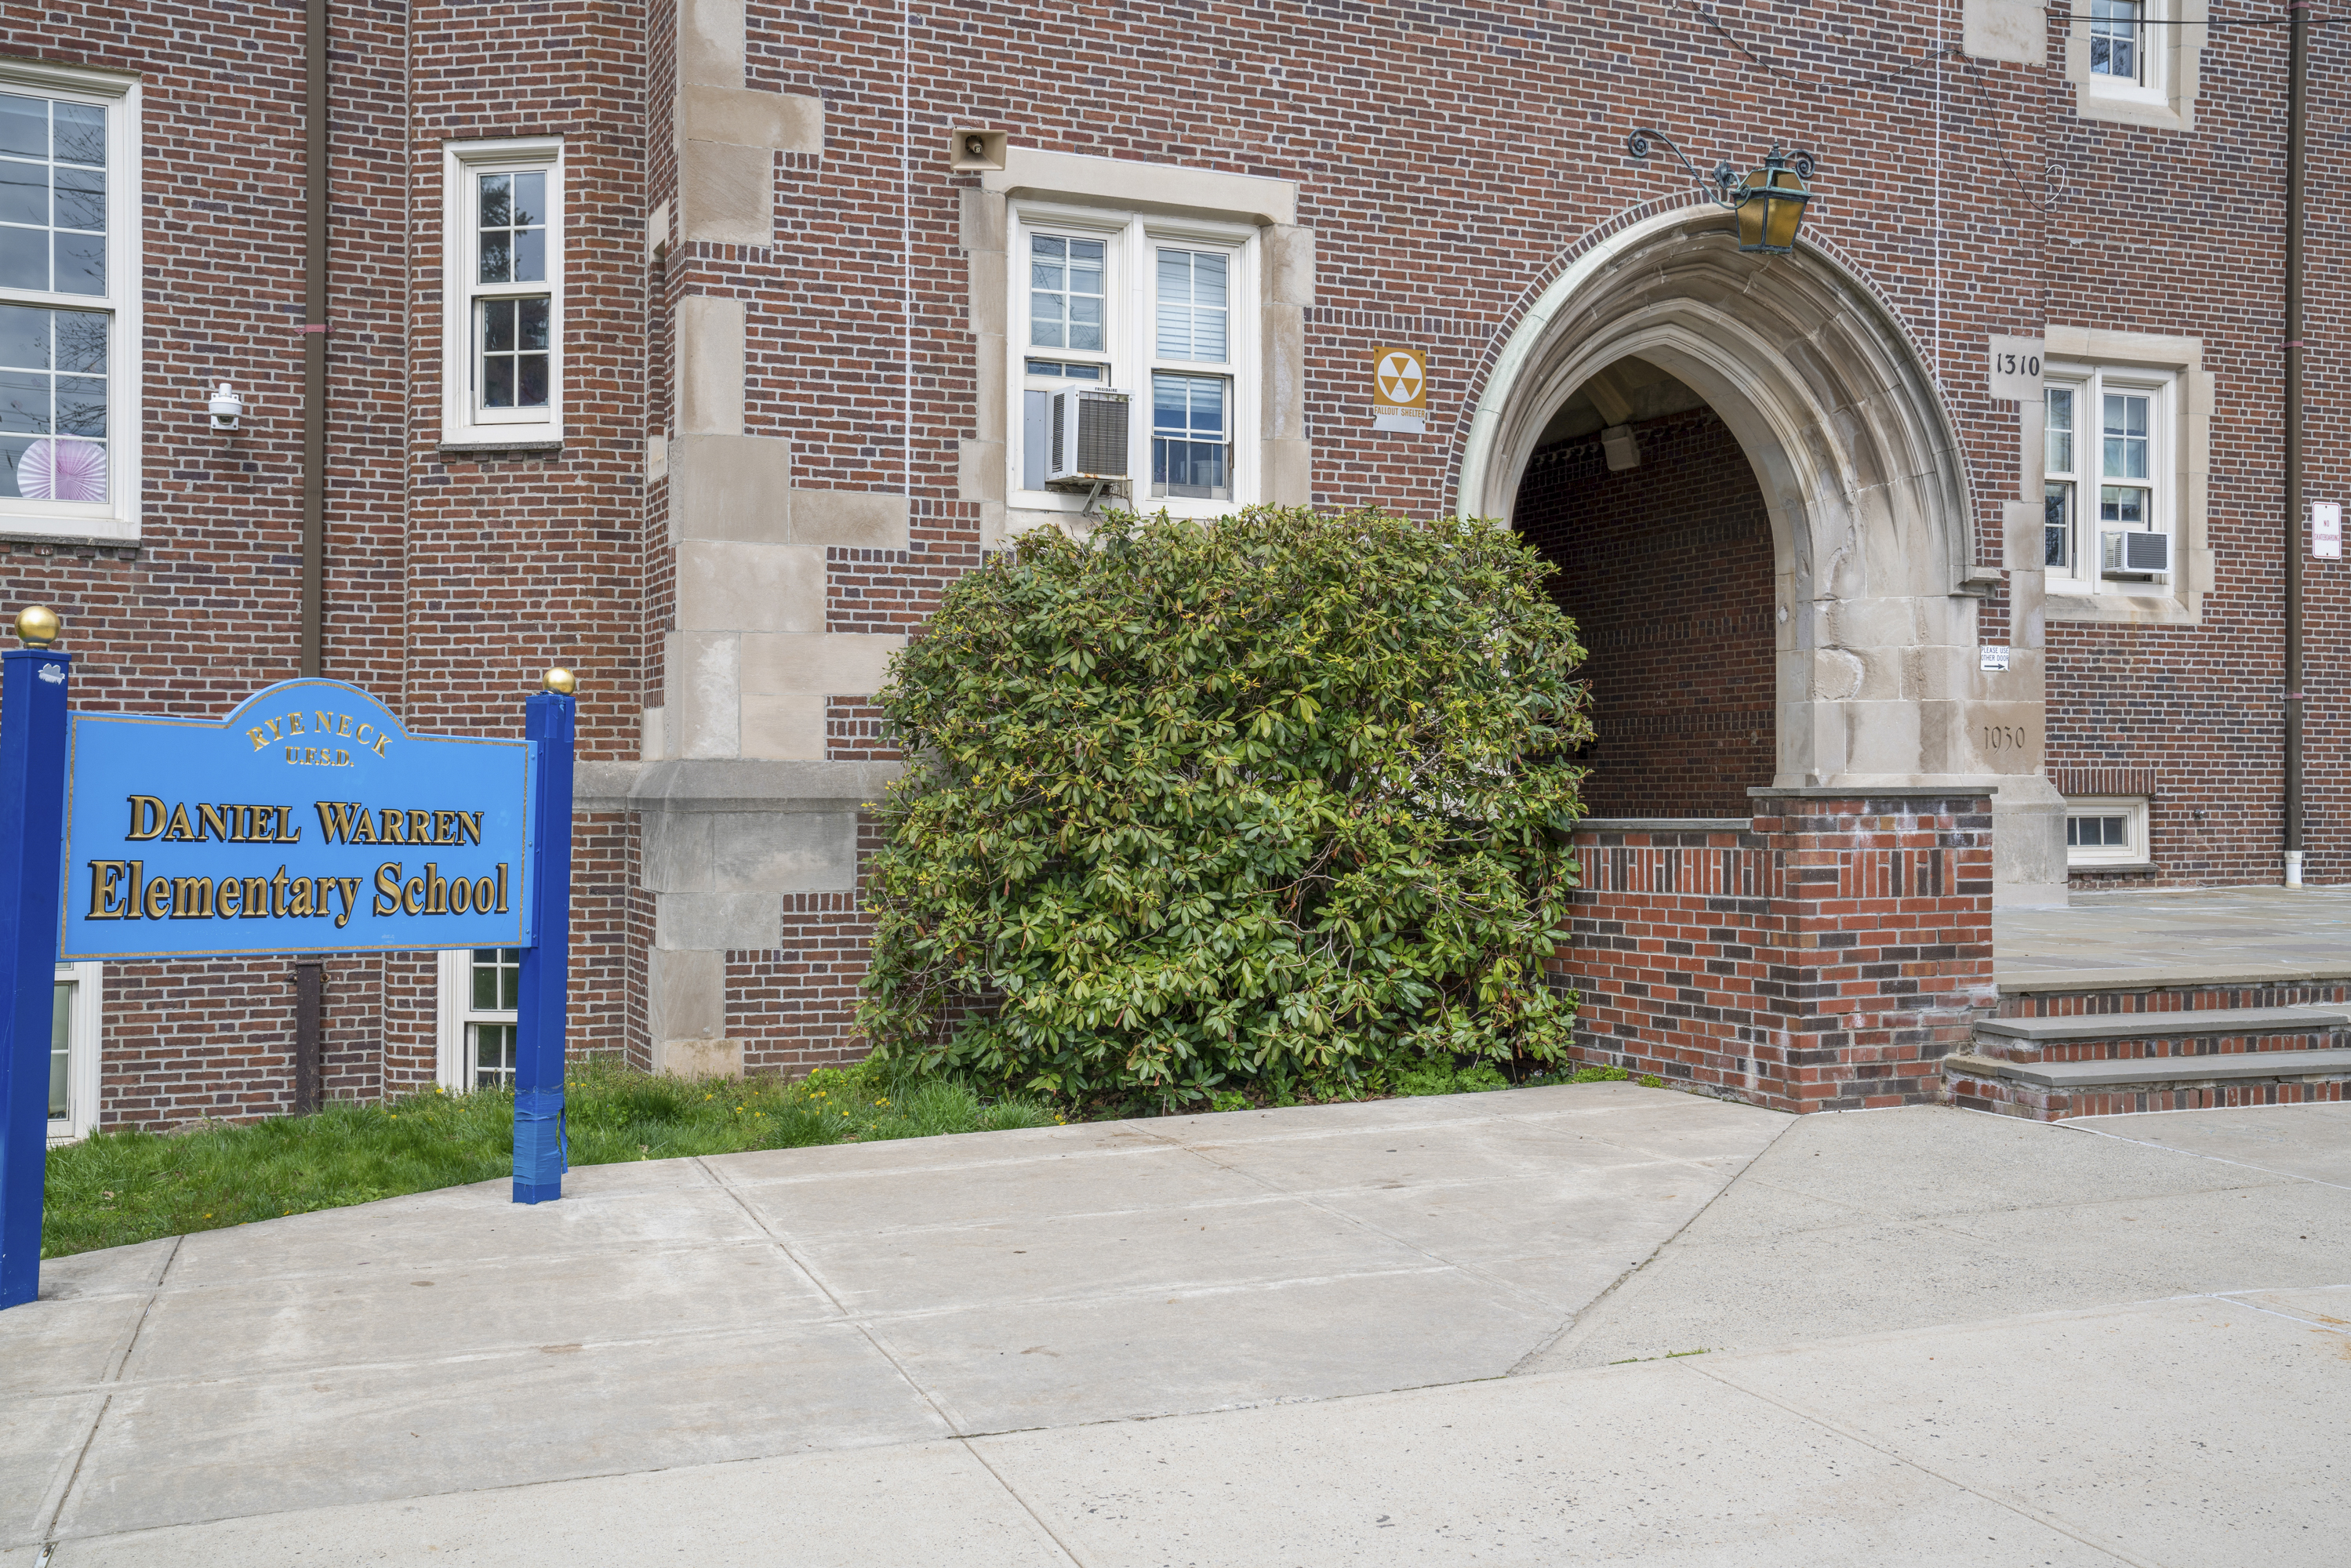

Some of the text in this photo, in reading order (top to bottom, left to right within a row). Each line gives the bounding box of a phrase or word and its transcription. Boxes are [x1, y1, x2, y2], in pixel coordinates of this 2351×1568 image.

[1997, 353, 2040, 376] 1310
[1374, 406, 1426, 418] FALLOUT SHELTER
[2314, 533, 2339, 542] SKATEBOARDING
[245, 710, 393, 759] RYE NECK
[1984, 726, 2026, 755] 1930
[285, 746, 354, 768] U.F.S.D.
[85, 859, 509, 929] Elementary School
